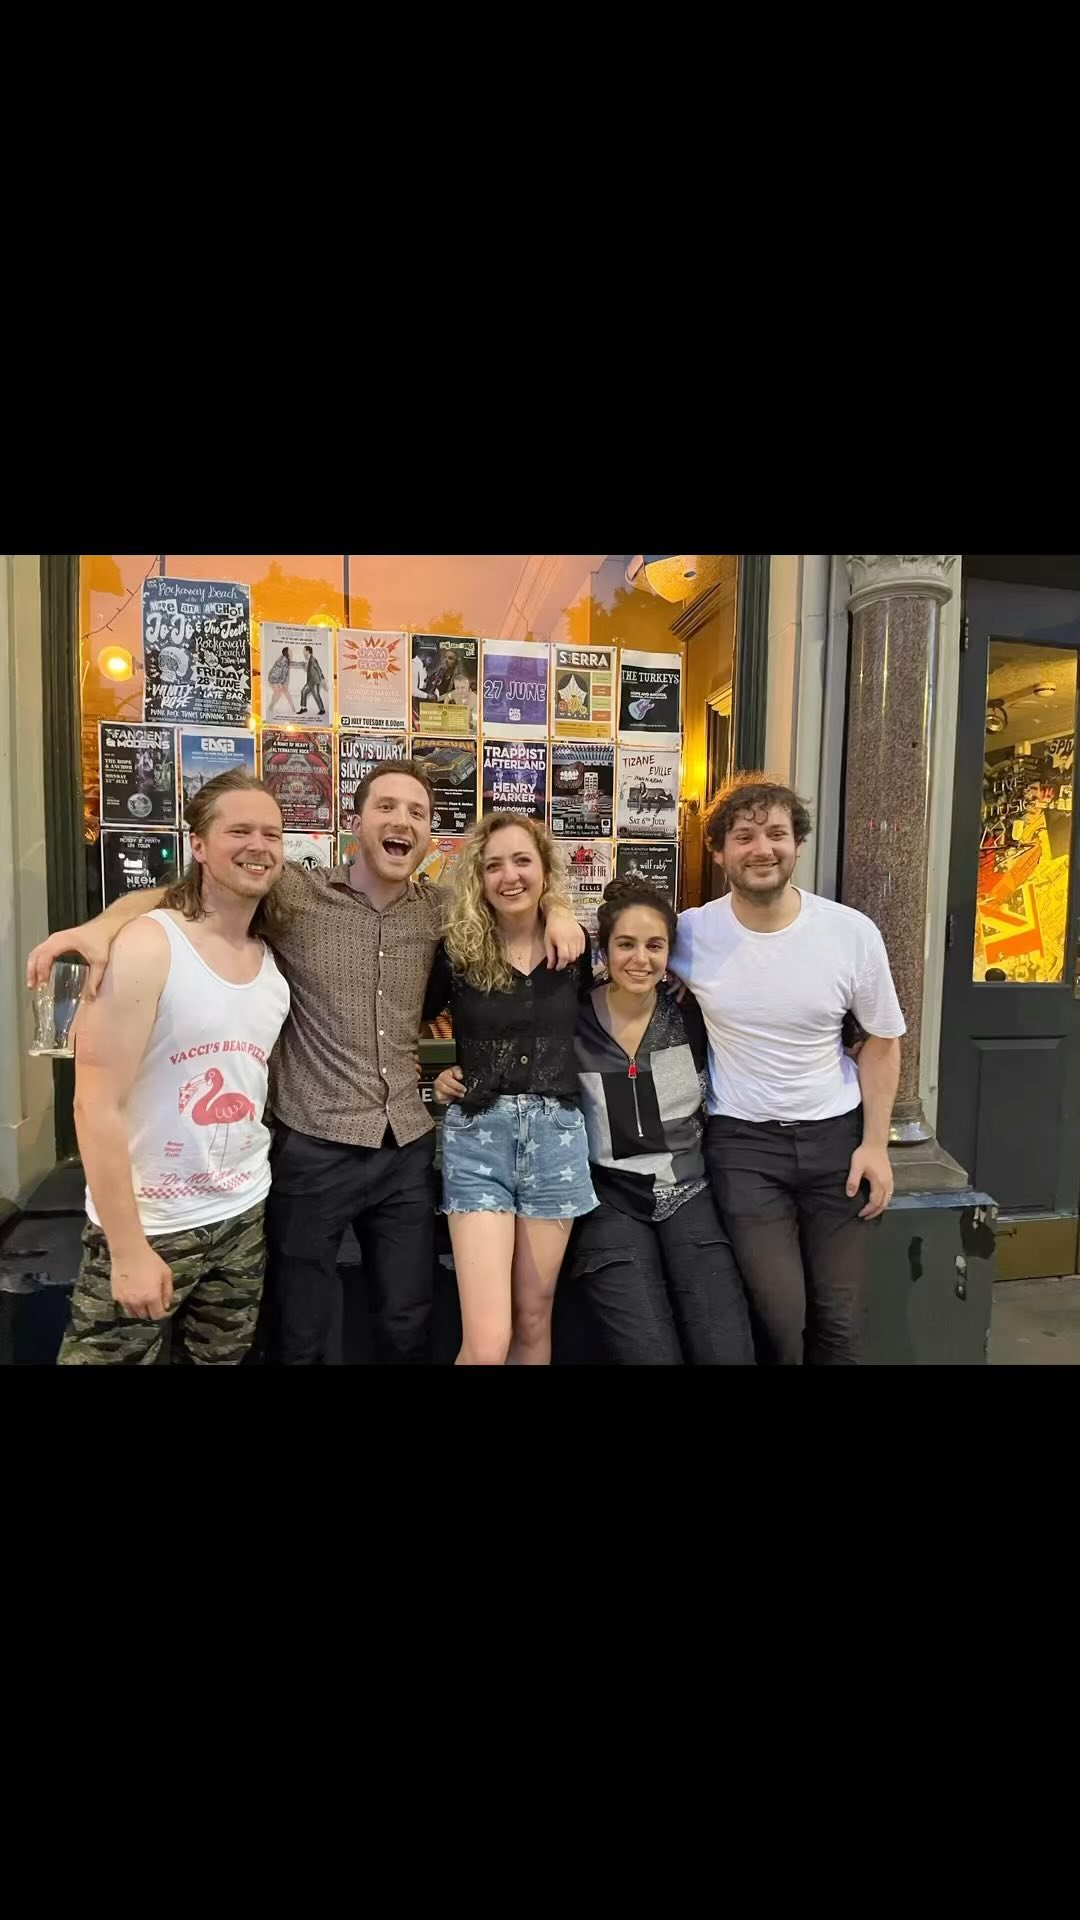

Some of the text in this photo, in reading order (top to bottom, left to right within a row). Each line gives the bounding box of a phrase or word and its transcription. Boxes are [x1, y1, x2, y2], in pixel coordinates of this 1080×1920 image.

[158, 582, 206, 602] Rockaway
[207, 585, 238, 599] Beach
[145, 612, 195, 645] Jo-Jo
[203, 619, 221, 636] The
[196, 666, 243, 681] FRIDAY
[622, 669, 680, 685] THE TURKEYS
[196, 676, 241, 690] 28 JUNE
[203, 690, 243, 702] LATE BAR
[483, 679, 547, 702] 27 JUNE
[351, 717, 362, 725] JULY
[363, 718, 384, 726] TUESDAY
[117, 740, 170, 750] MODERNS
[340, 741, 404, 760] LUCY'S DIARY
[484, 746, 546, 760] TRAPPIST
[483, 758, 546, 771] AFTERLAND
[622, 754, 656, 768] TIZANE
[648, 767, 672, 777] EVILLE
[493, 782, 536, 794] HENRY
[993, 777, 1023, 793] LIVE
[493, 793, 536, 803] PARKER
[628, 816, 640, 825] SAT
[651, 817, 666, 827] JULY
[640, 860, 654, 870] wilf
[653, 860, 667, 872] raby
[126, 876, 156, 885] NEON
[169, 1042, 220, 1065] VACCI'S
